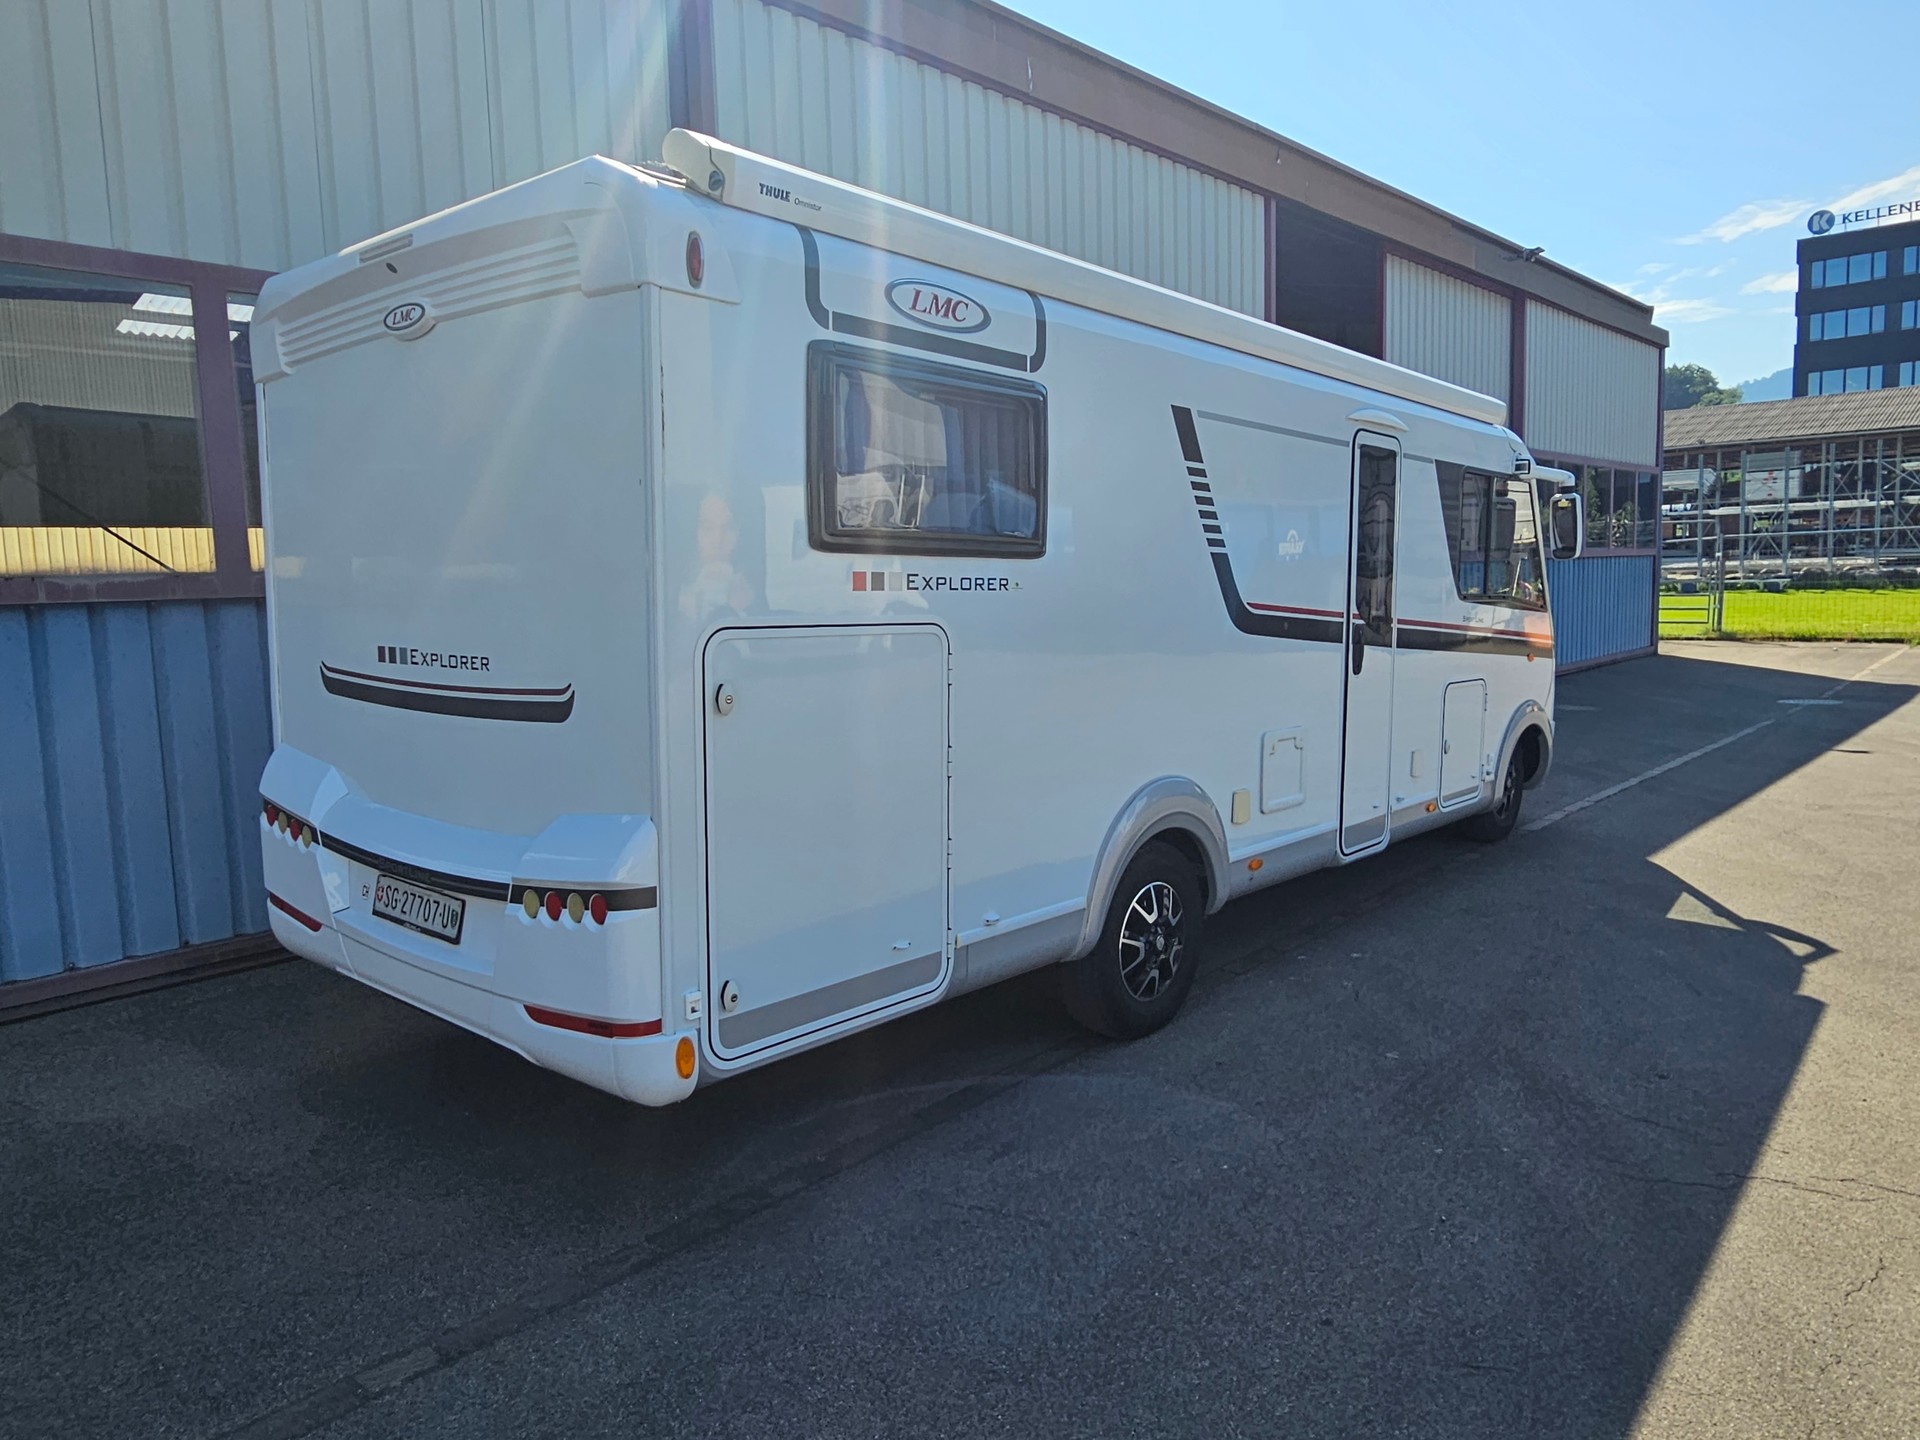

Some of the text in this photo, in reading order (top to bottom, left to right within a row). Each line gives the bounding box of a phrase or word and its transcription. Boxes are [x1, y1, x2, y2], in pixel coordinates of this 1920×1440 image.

[759, 182, 791, 202] THULE
[909, 287, 969, 322] LMC
[392, 307, 416, 326] LMC
